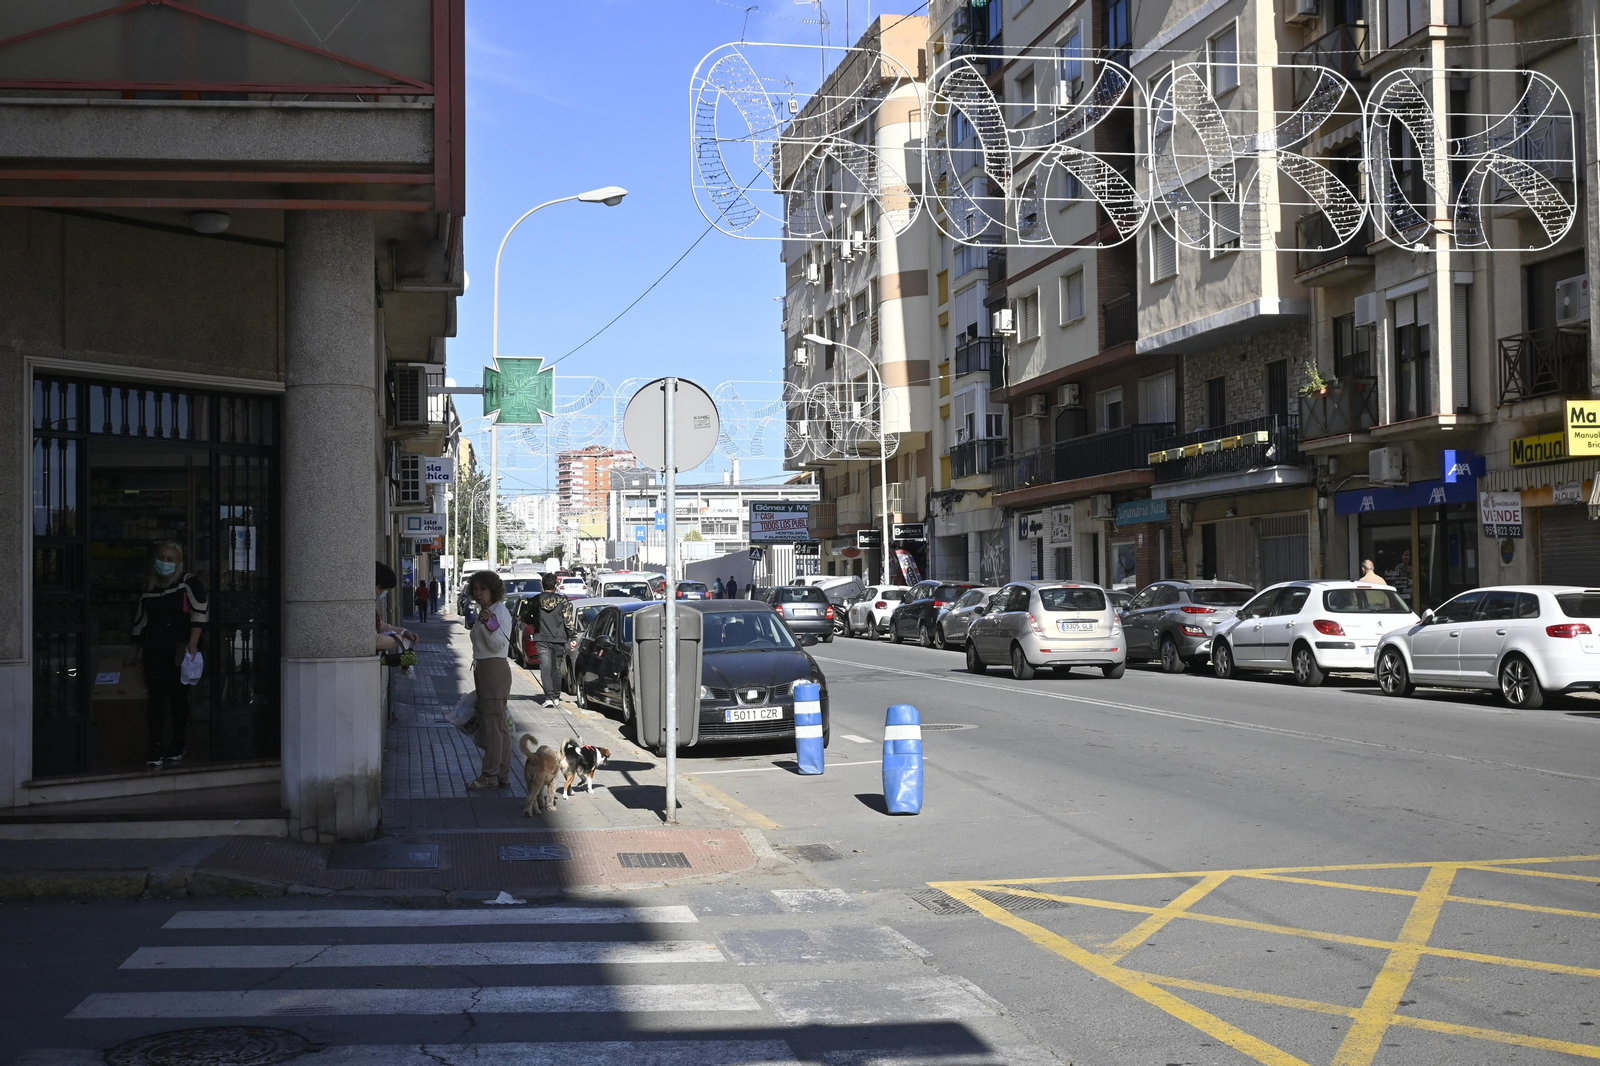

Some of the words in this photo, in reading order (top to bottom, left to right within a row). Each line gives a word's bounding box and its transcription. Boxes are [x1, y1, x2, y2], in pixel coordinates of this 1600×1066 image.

[1571, 407, 1597, 423] Ma
[1448, 463, 1471, 476] AXA
[1429, 487, 1447, 504] AXA
[1359, 495, 1375, 512] AXA
[760, 520, 779, 531] TODOS
[780, 519, 791, 529] LOS
[1029, 519, 1043, 536] dipo
[1509, 526, 1521, 536] 522
[795, 544, 807, 554] 24
[733, 710, 757, 720] 5011
[760, 708, 778, 719] CZR
